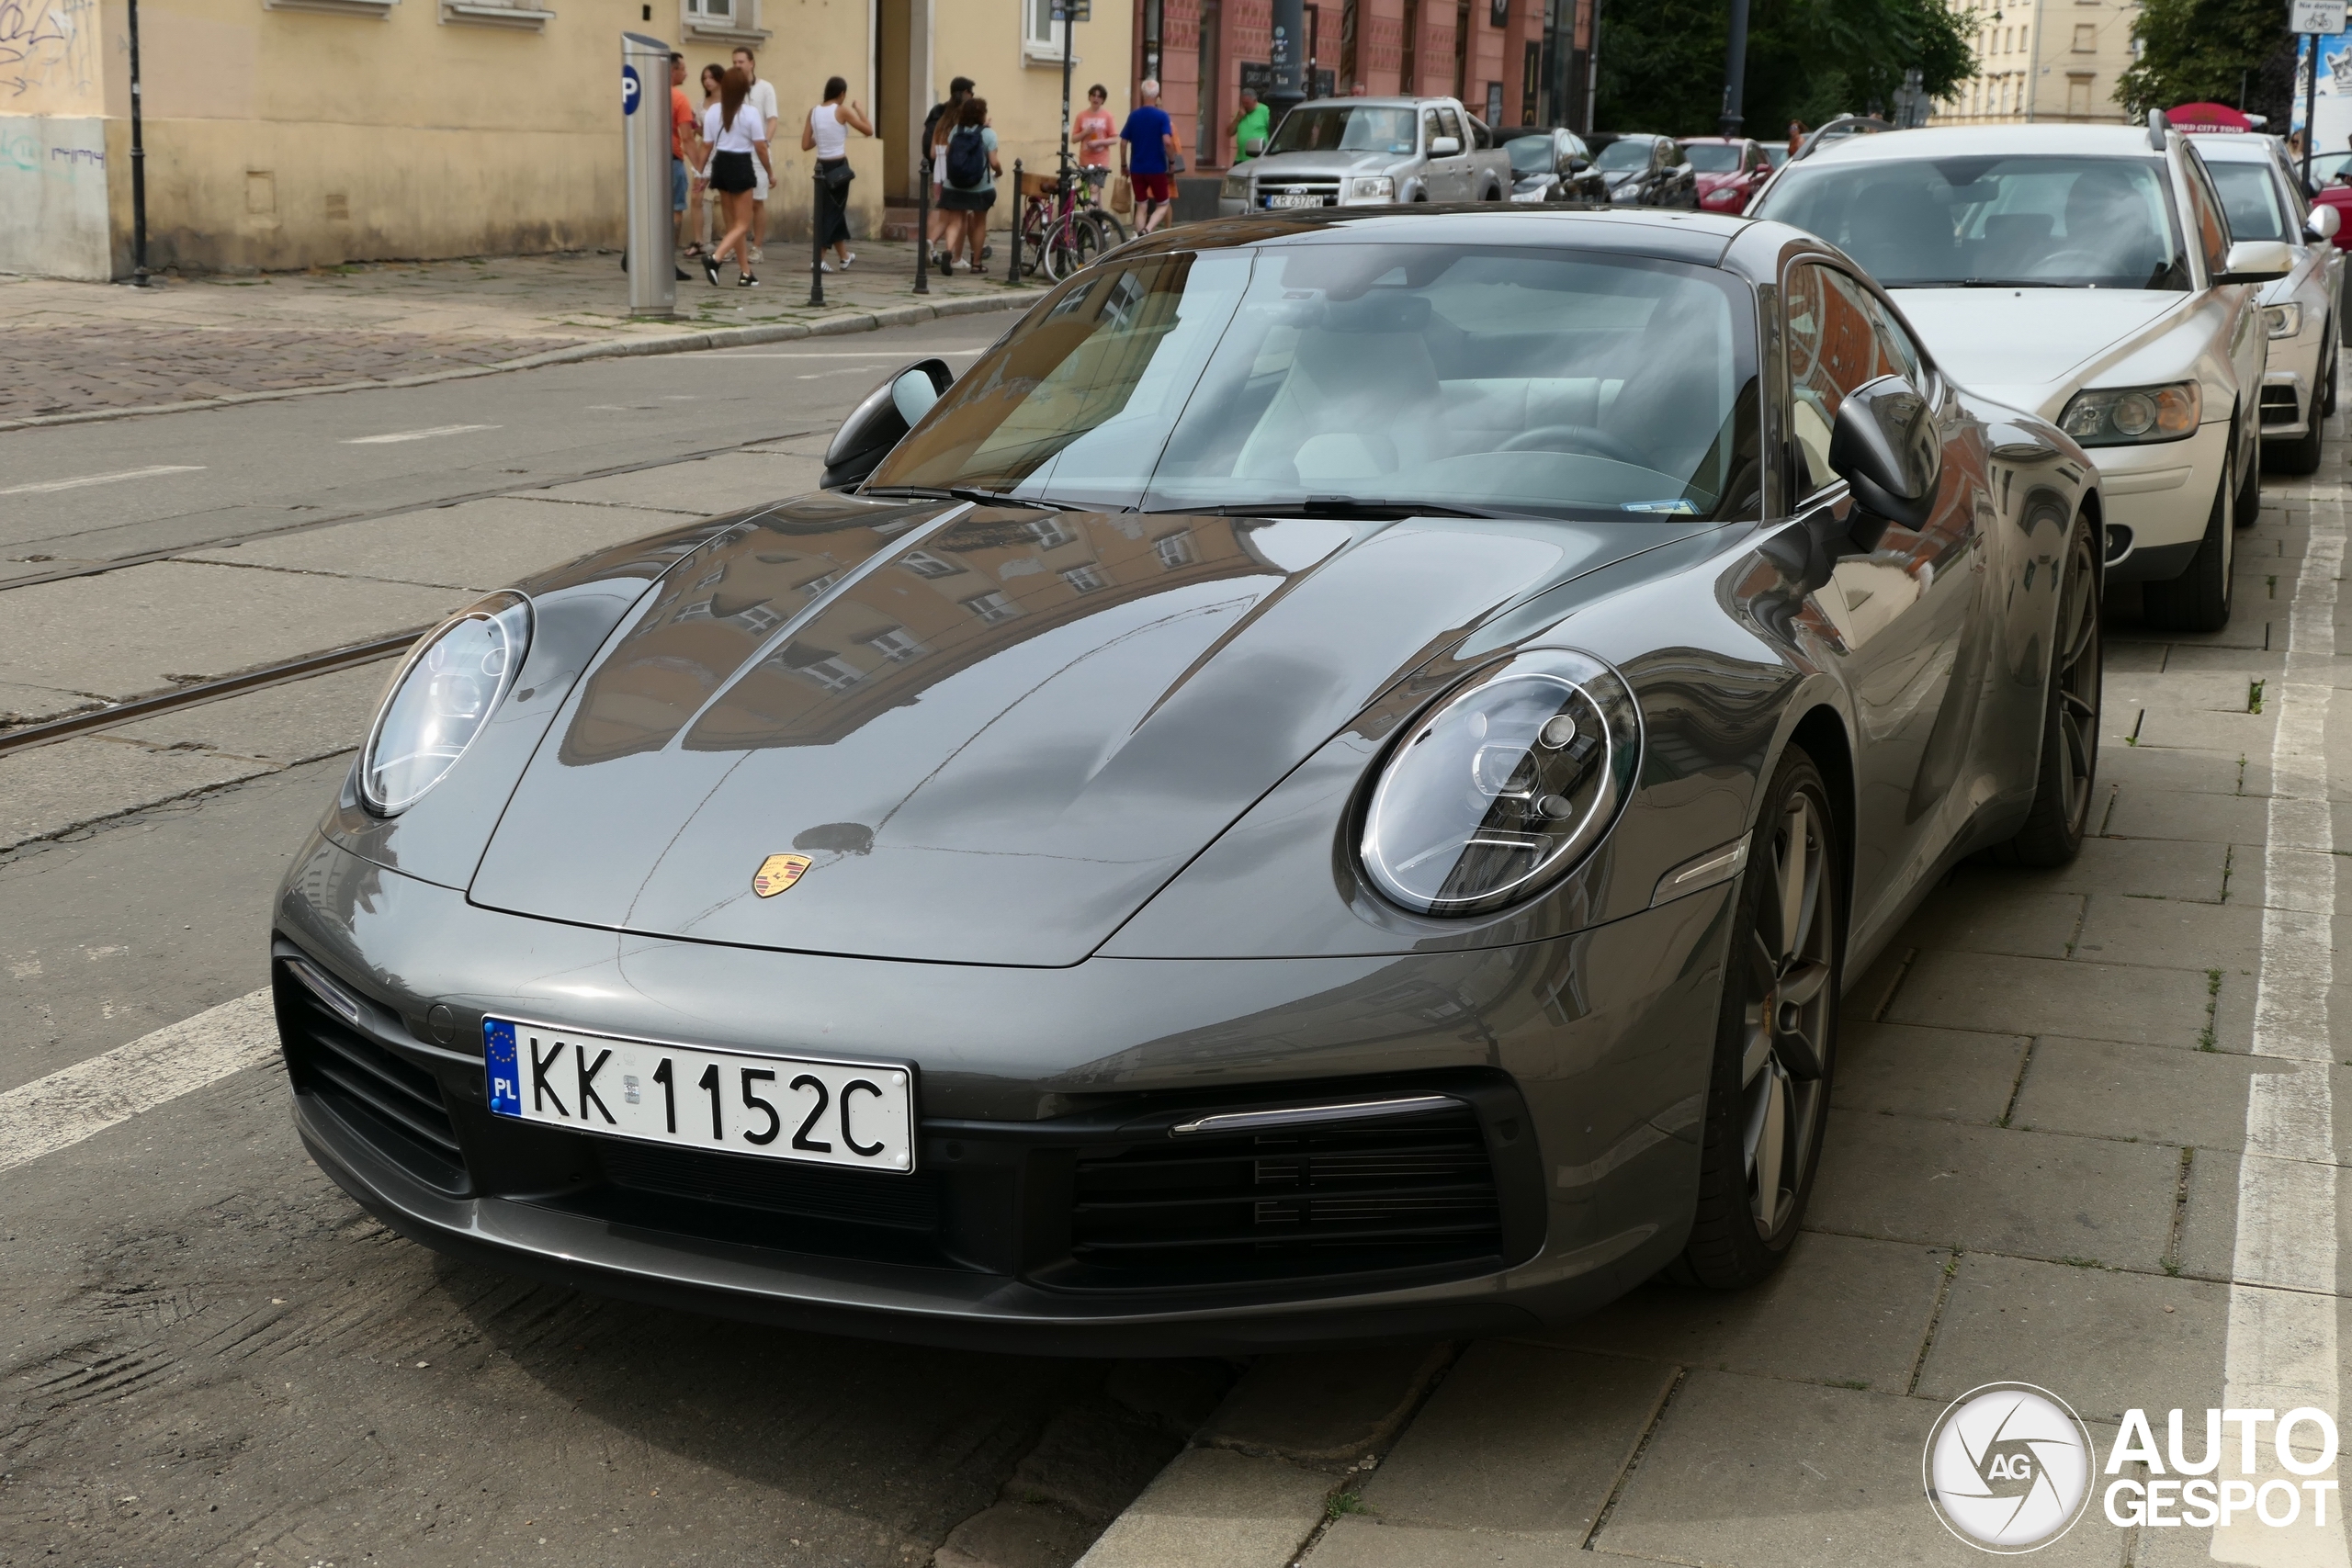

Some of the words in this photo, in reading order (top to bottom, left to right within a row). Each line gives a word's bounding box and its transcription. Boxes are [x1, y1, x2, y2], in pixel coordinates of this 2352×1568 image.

[622, 77, 638, 103] P
[2197, 124, 2218, 132] CITY
[2220, 125, 2244, 133] TOUR
[1272, 196, 1287, 207] KR
[494, 1077, 516, 1100] PL
[529, 1036, 616, 1125] KK
[651, 1057, 886, 1157] 1152C
